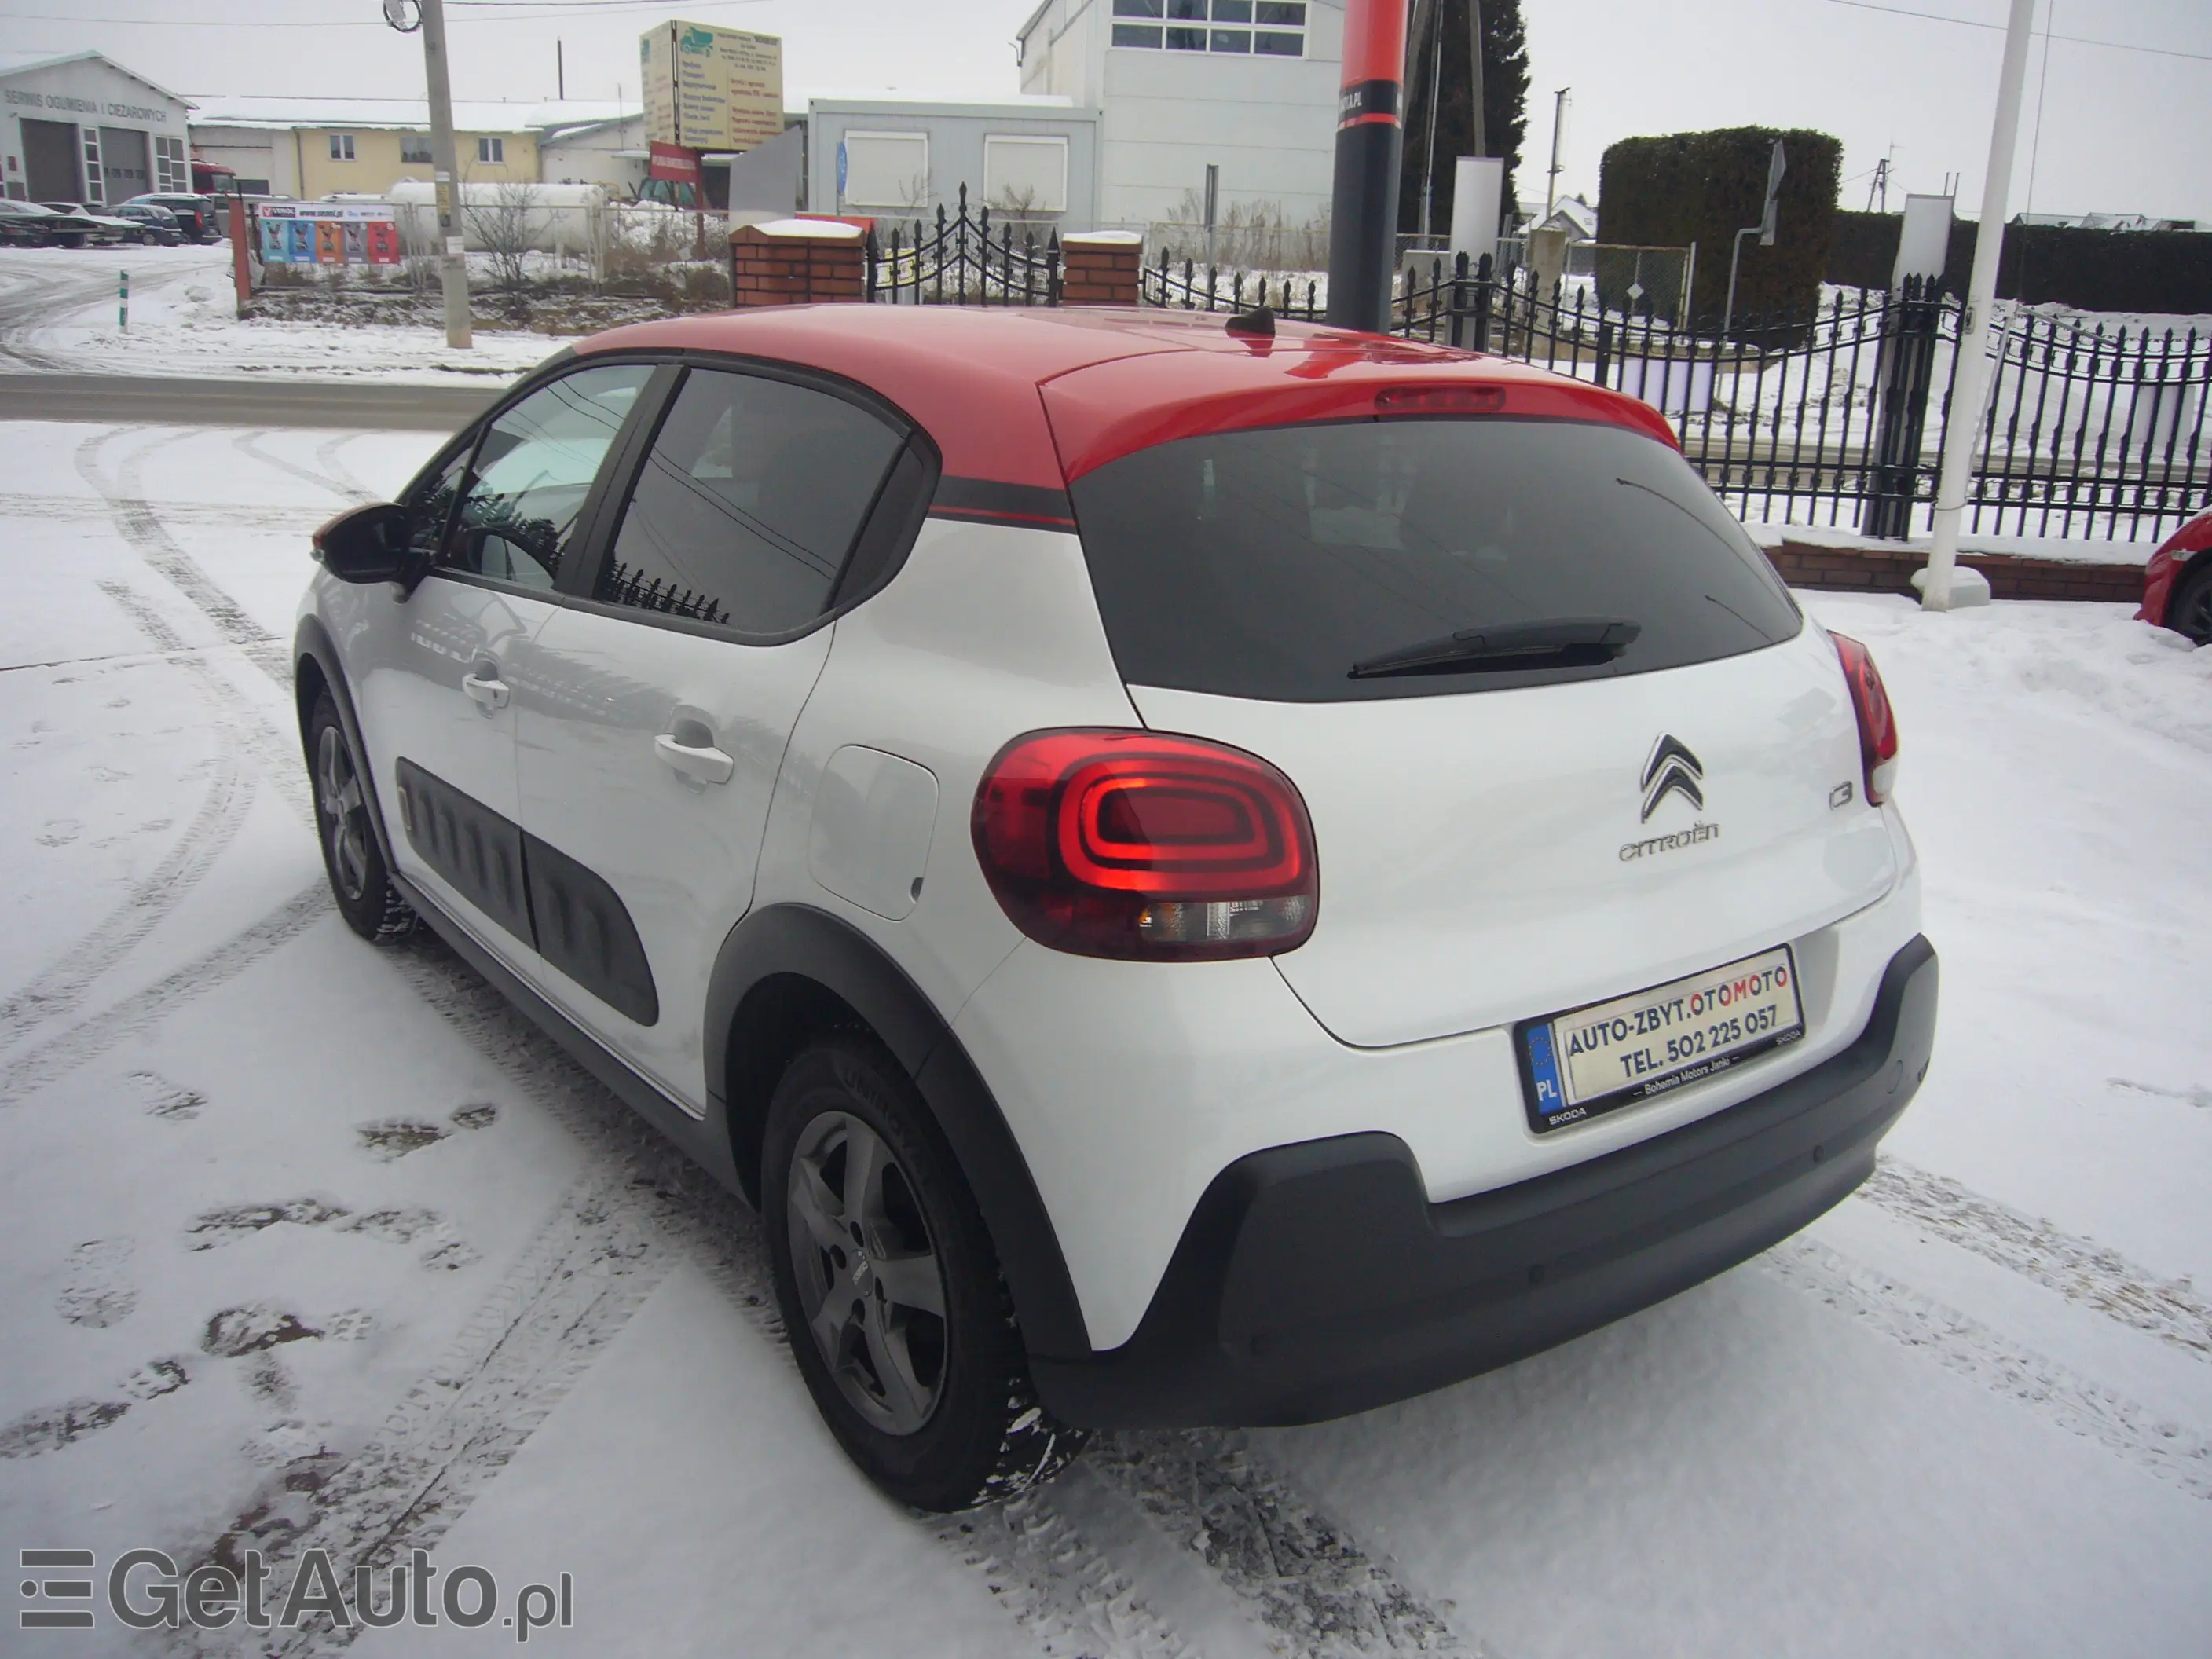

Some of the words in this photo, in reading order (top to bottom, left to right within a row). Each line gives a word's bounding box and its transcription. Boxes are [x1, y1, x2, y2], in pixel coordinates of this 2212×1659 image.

[5, 90, 43, 107] SERWIS
[46, 94, 99, 114] OGUMIENIA
[1569, 965, 1788, 1057] AUTO-ZBYT.OTOMOTO
[1619, 1047, 1664, 1079] TEL.
[1667, 1030, 1706, 1062] 502
[1708, 1018, 1741, 1049] 225
[1745, 1005, 1778, 1035] 057
[1536, 1079, 1557, 1101] PL
[1645, 1075, 1681, 1095] Bohemia
[1679, 1064, 1709, 1082] Motors
